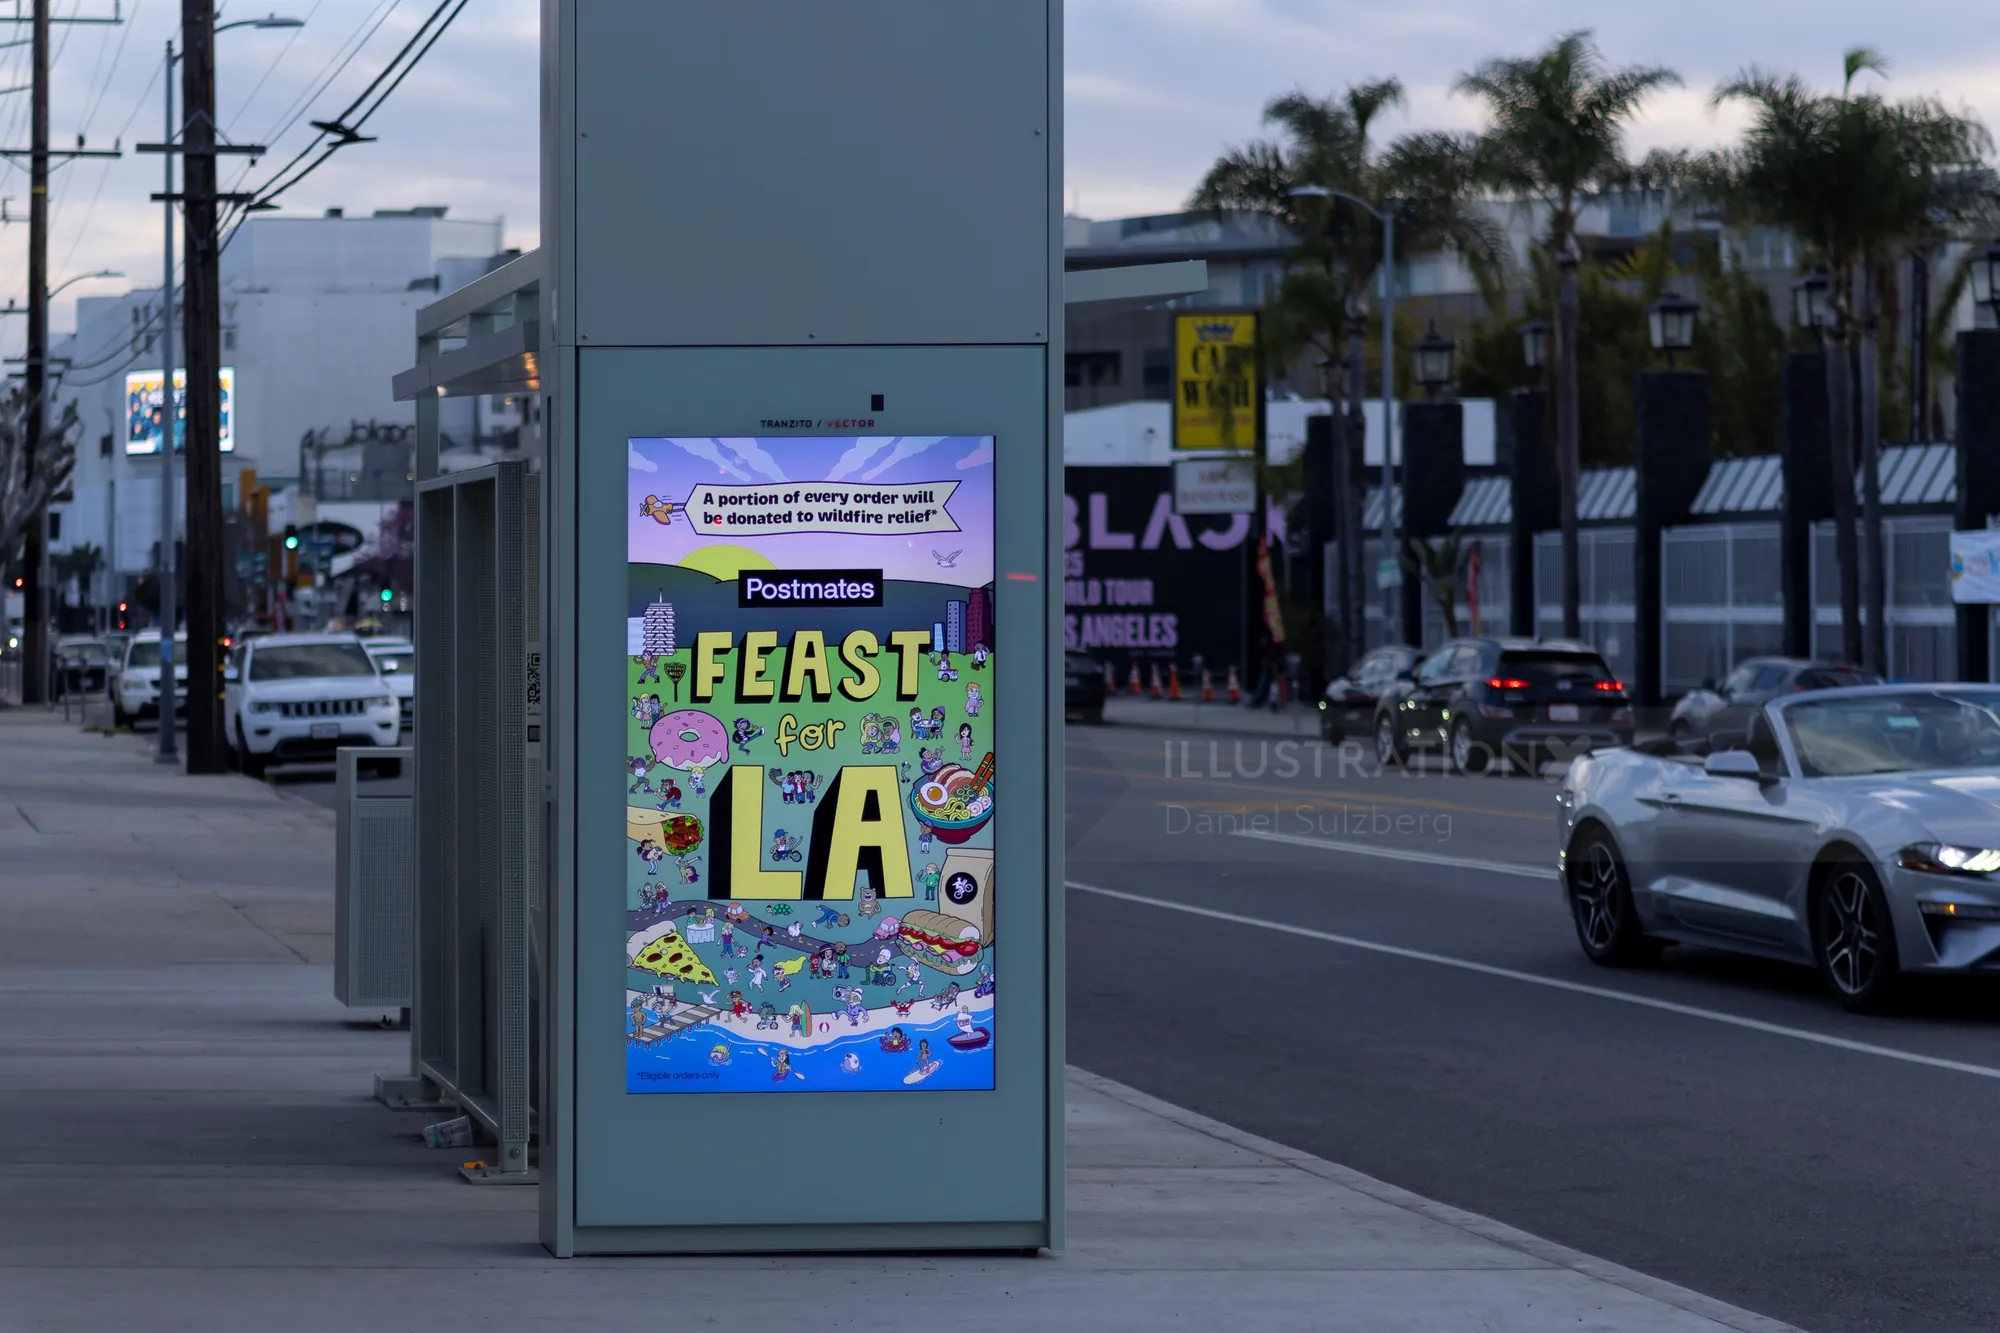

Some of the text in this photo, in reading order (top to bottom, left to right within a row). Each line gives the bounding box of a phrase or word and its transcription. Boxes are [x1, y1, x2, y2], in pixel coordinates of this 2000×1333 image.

[760, 419, 813, 428] TRANZITO
[826, 419, 875, 428] VECTOR
[702, 490, 935, 508] A portion of every order will
[703, 511, 723, 525] be
[726, 511, 793, 525] donated
[796, 510, 814, 523] to
[817, 508, 884, 524] wildfire
[746, 578, 876, 600] Postmates
[1104, 578, 1154, 605] TOUR
[1081, 612, 1179, 648] ANGELES
[690, 629, 932, 704] FEAST
[774, 713, 846, 757] for
[707, 765, 915, 901] LA
[673, 1071, 700, 1080] orders
[701, 1071, 720, 1081] only
